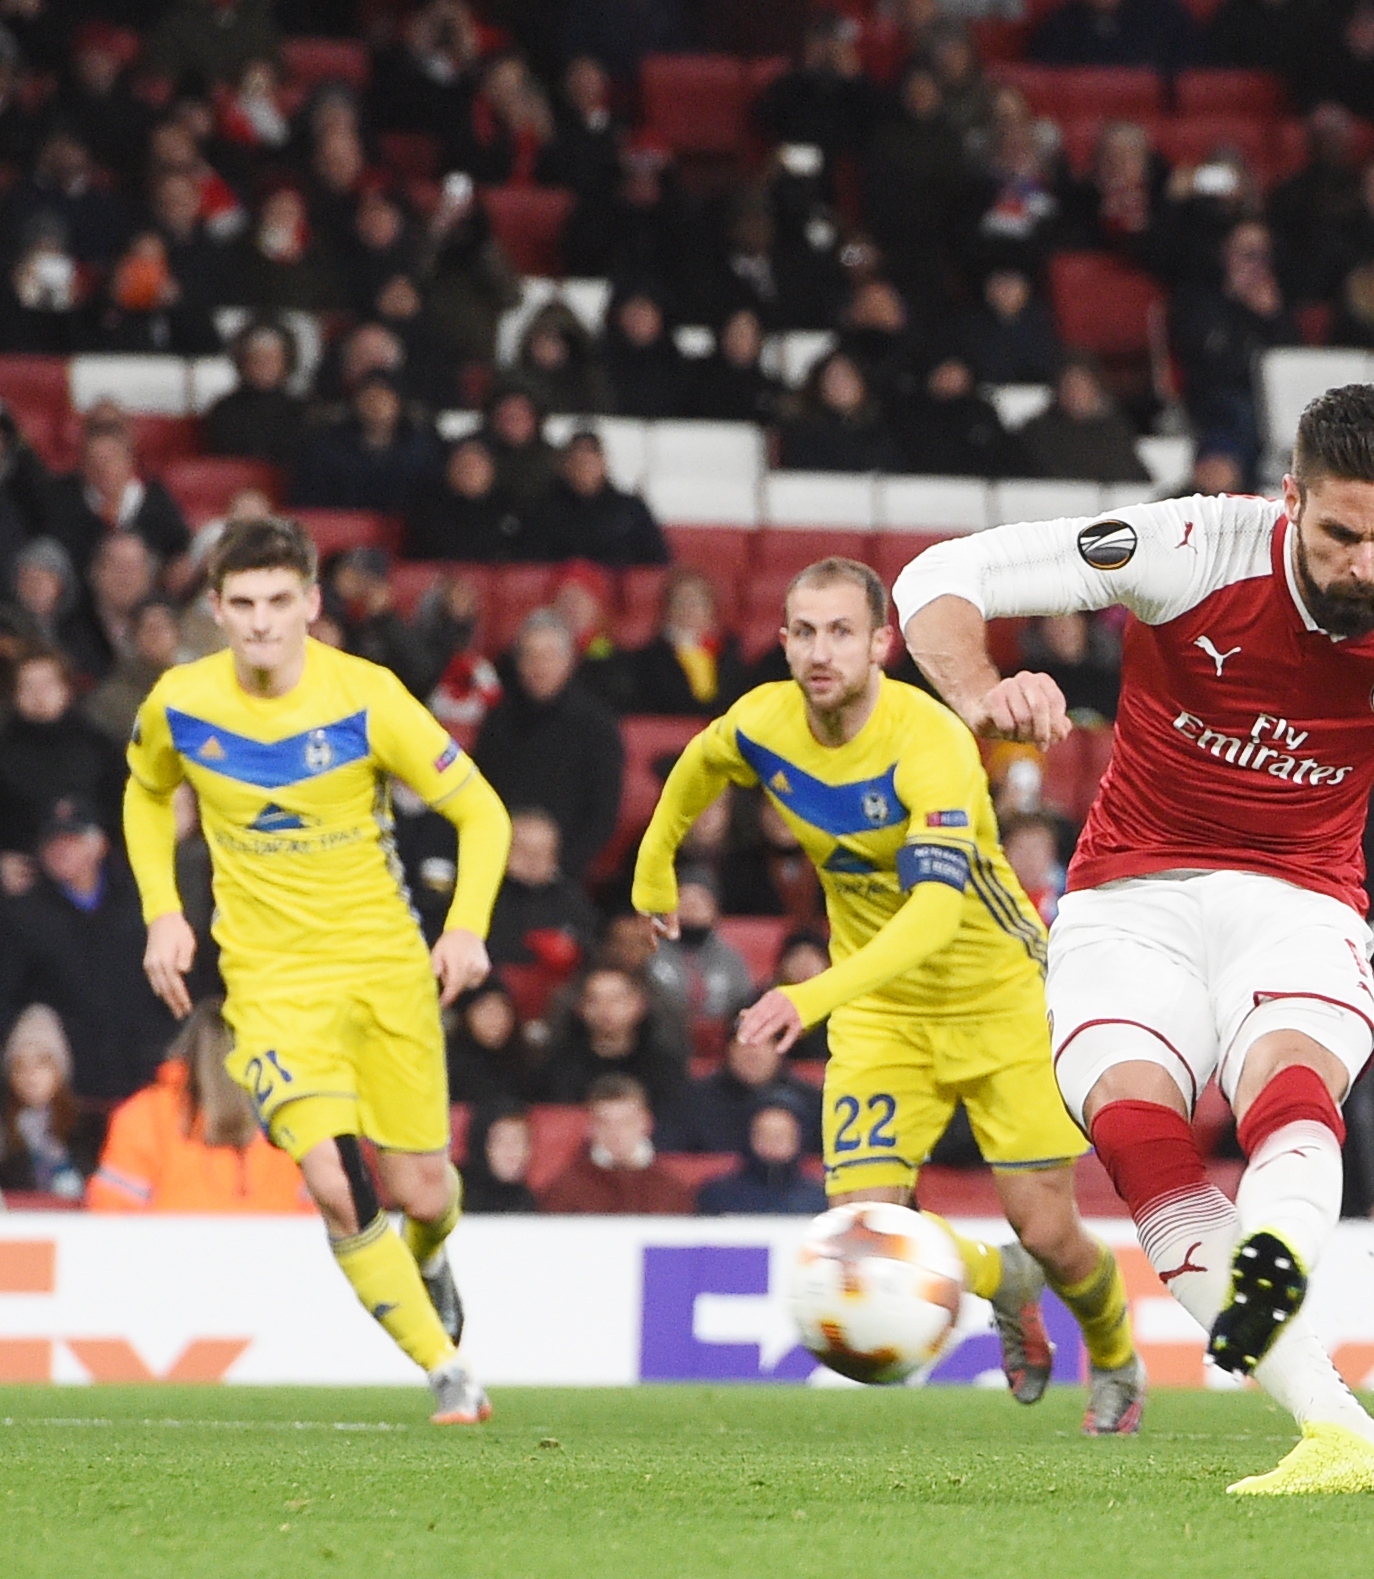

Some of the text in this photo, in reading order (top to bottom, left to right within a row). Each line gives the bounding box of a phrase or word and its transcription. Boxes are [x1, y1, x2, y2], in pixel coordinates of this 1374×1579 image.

[1172, 711, 1354, 786] Emirates
[1250, 713, 1309, 750] Fly
[244, 1050, 292, 1105] 21
[834, 1093, 897, 1154] 22
